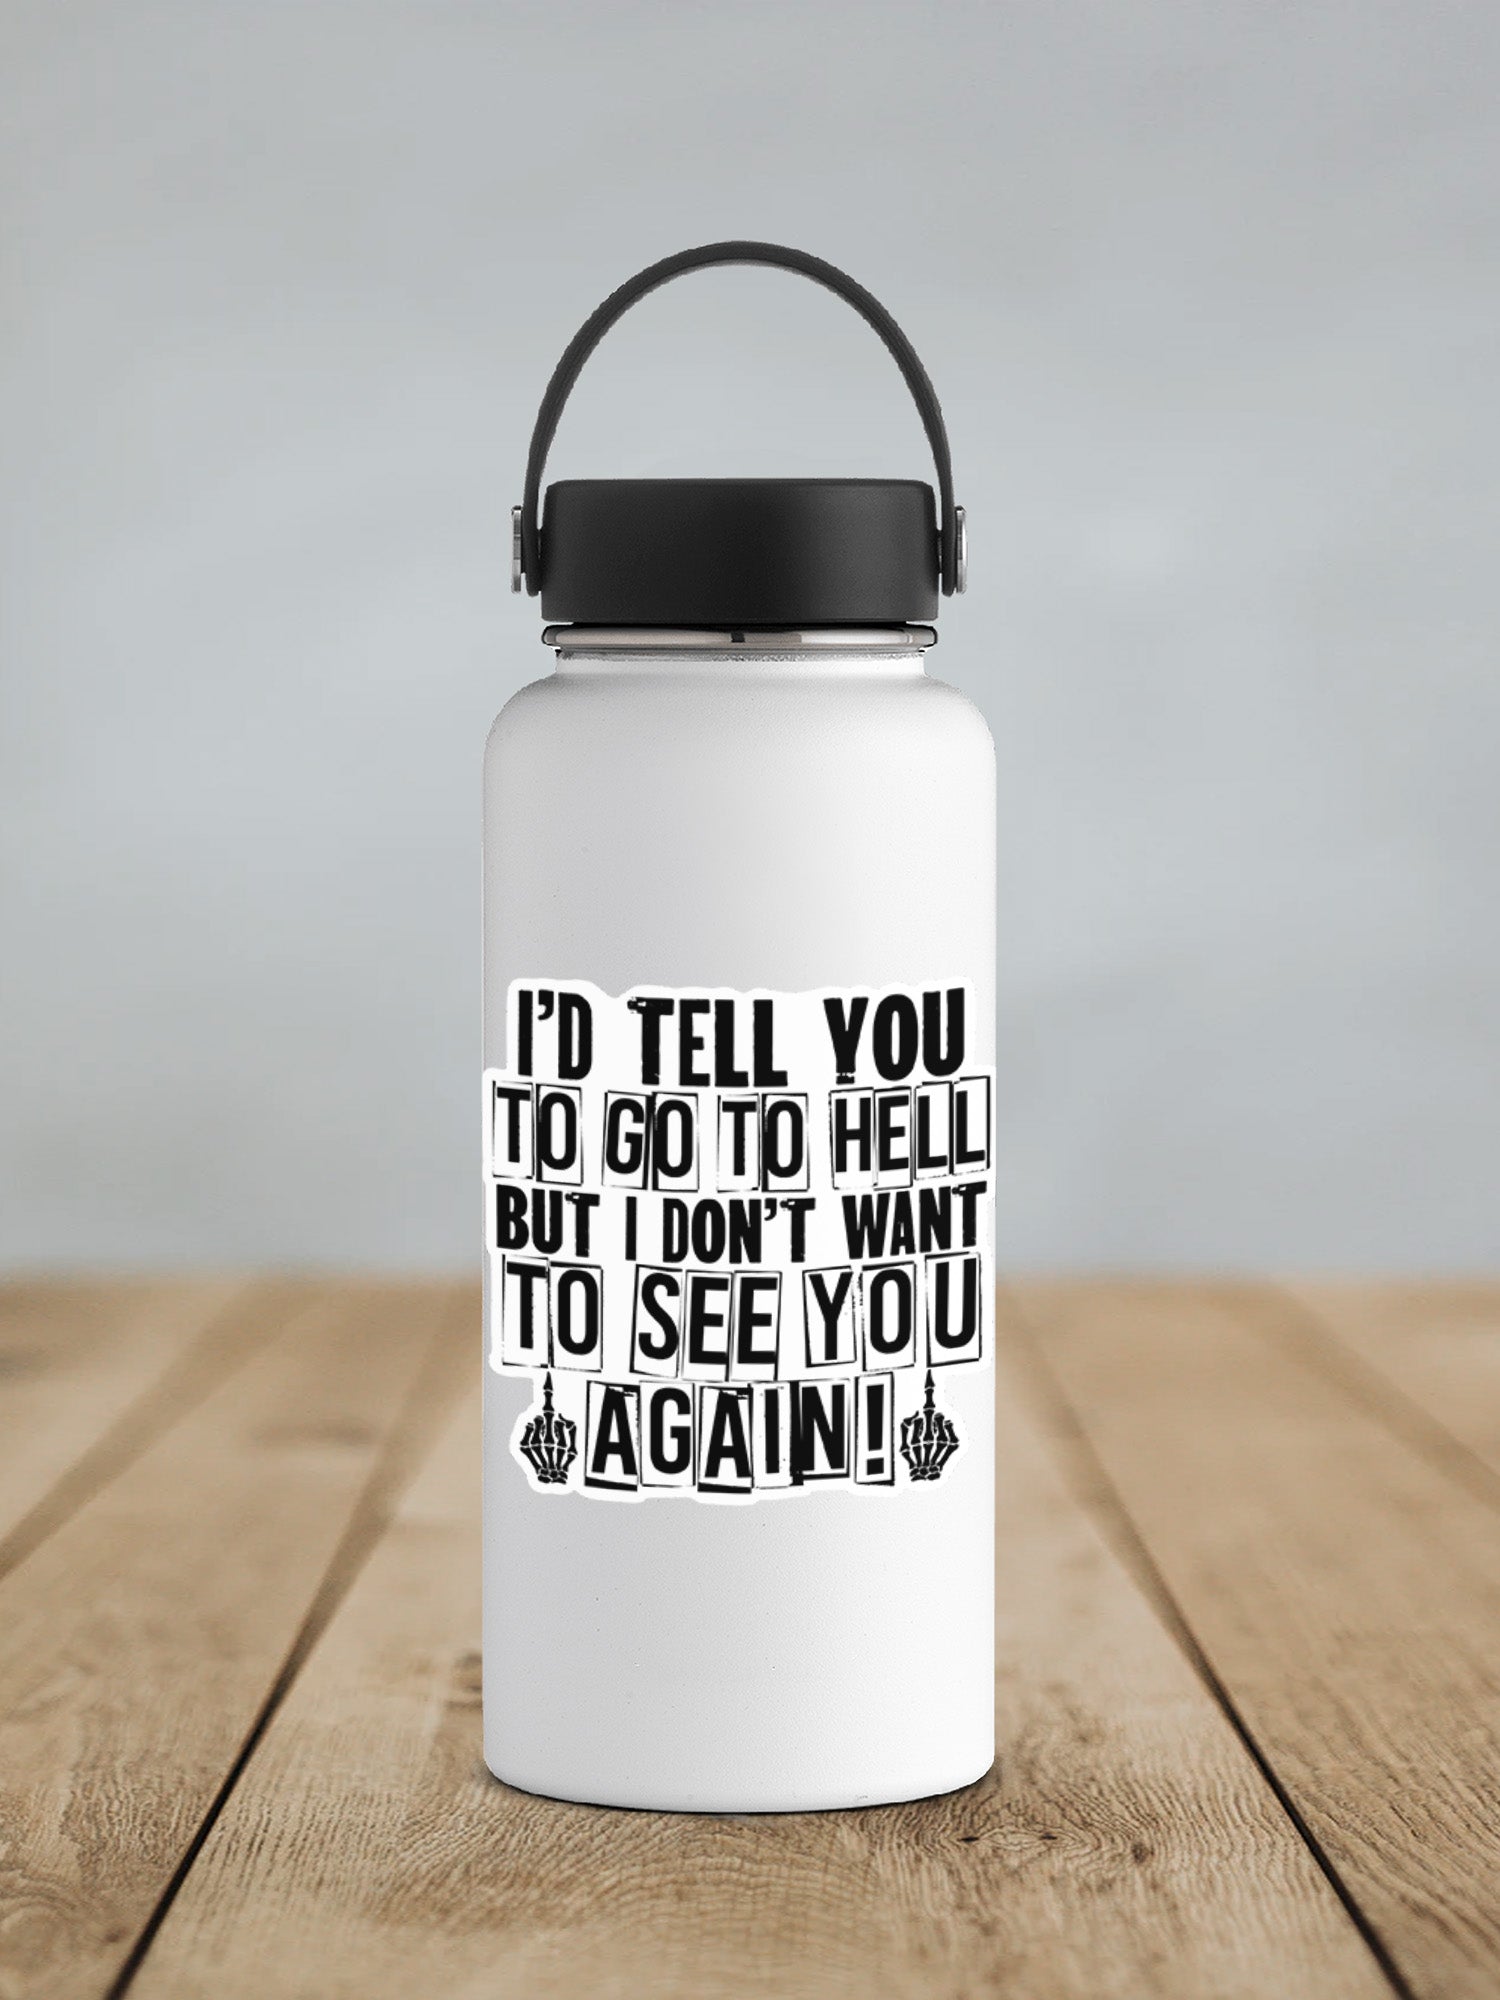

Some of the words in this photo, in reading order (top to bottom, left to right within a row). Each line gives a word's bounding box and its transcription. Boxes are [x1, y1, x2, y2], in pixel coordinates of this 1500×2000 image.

[518, 989, 593, 1081] I'D
[627, 996, 788, 1087] TELL
[823, 987, 965, 1084] YOU
[496, 1087, 577, 1171] TO
[605, 1097, 694, 1178] GO
[722, 1099, 804, 1178] TO
[834, 1089, 986, 1173] HELL
[496, 1184, 600, 1258] BUT
[625, 1196, 637, 1261] I
[662, 1197, 816, 1264] DON'T
[841, 1180, 987, 1260] WANT
[506, 1261, 599, 1356] TO
[638, 1271, 778, 1365] SEE
[809, 1260, 977, 1361] YOU
[590, 1383, 885, 1478] AGAIN!
